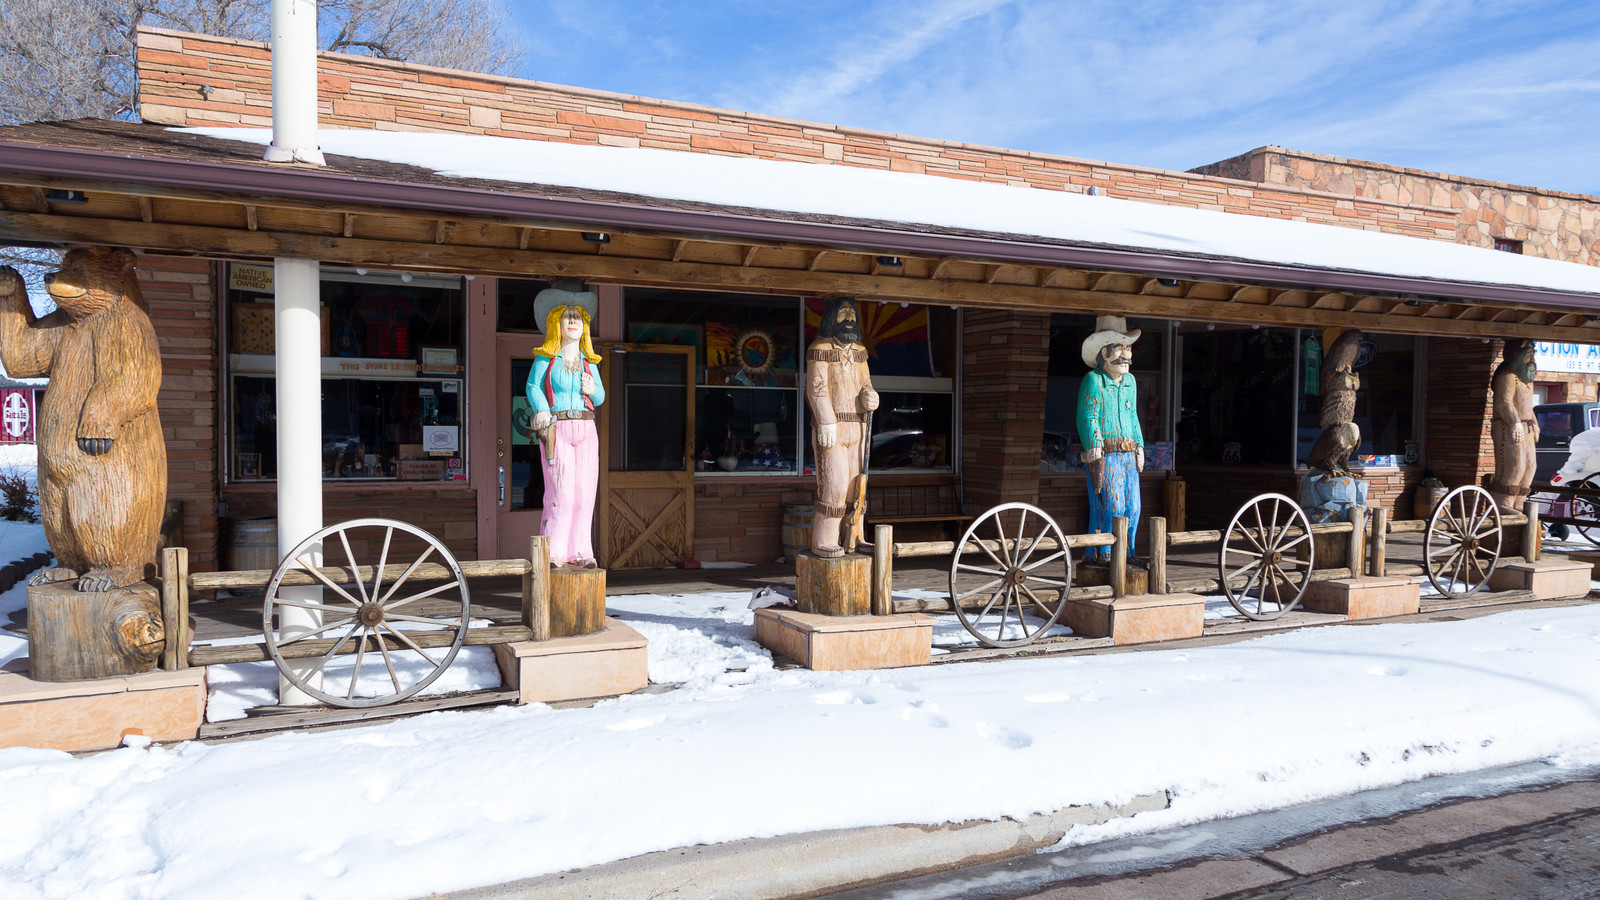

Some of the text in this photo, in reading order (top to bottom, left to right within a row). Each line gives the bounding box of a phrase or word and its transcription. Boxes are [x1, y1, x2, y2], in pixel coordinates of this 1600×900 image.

[239, 268, 268, 277] NATIVE
[233, 273, 272, 284] AMERICAN
[235, 280, 266, 289] OWNED
[361, 295, 411, 315] OPEN
[340, 363, 360, 371] THIS
[365, 362, 389, 370] STORE
[391, 363, 400, 371] IS
[1225, 450, 1239, 463] 66
